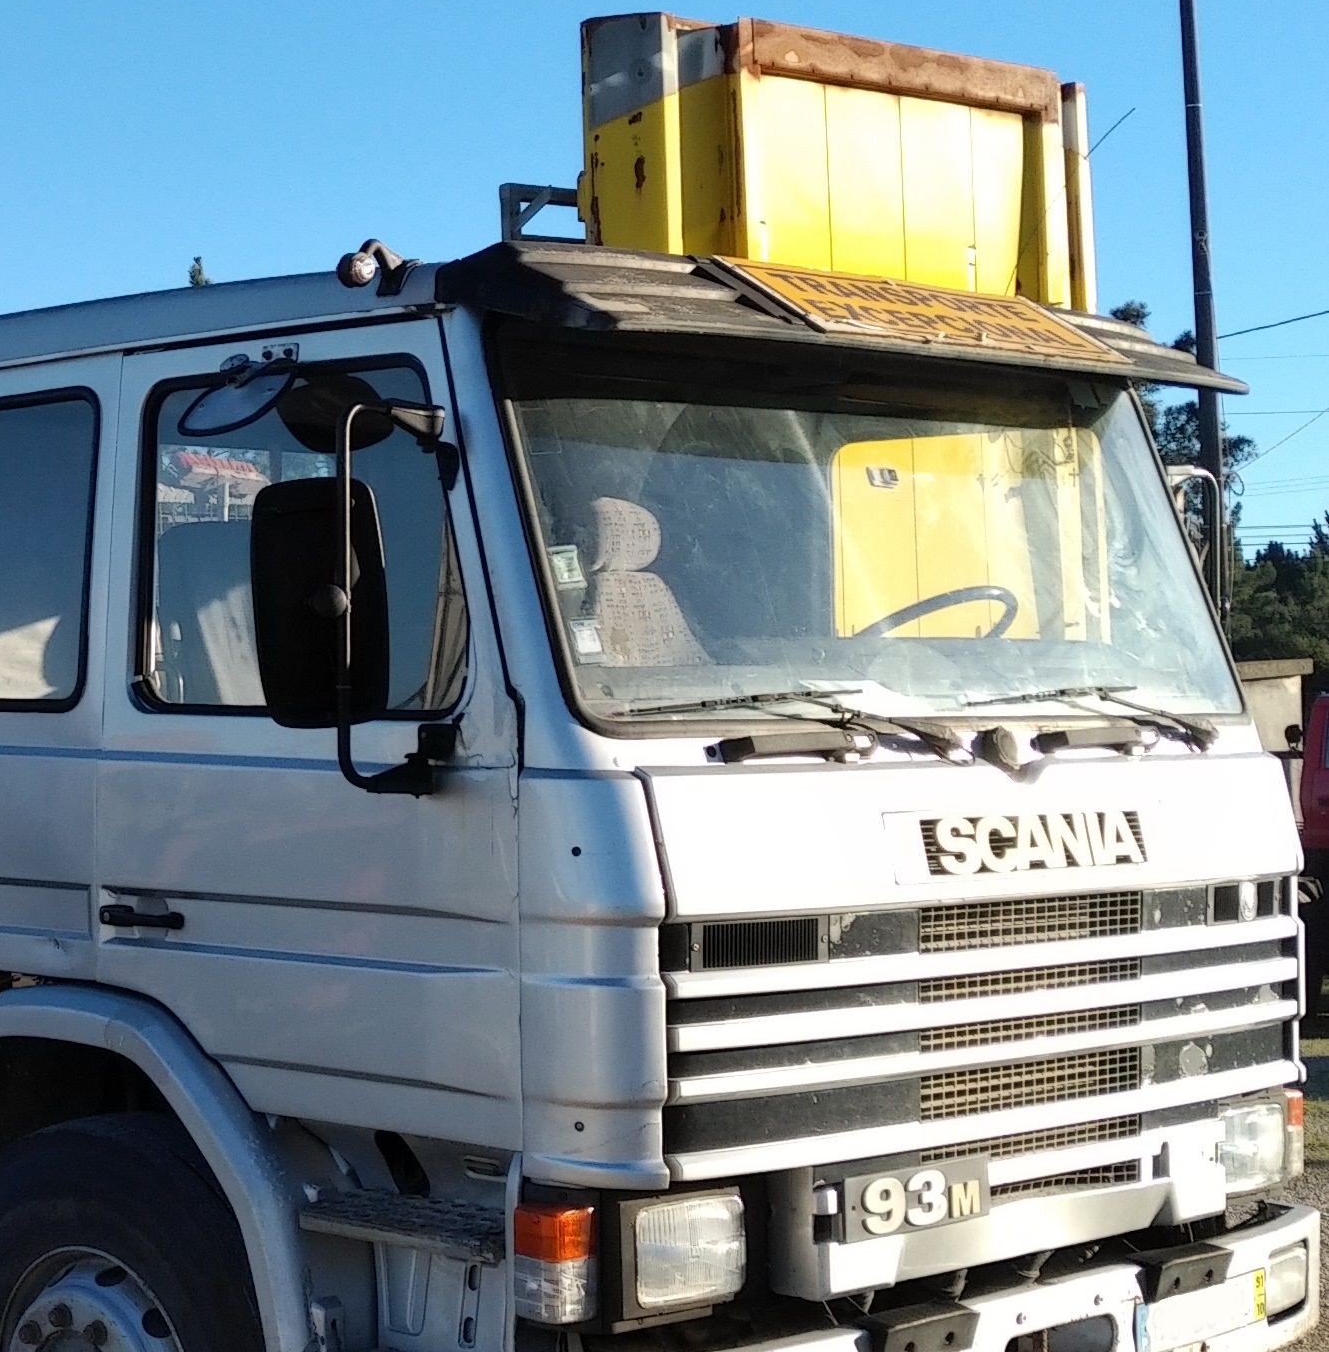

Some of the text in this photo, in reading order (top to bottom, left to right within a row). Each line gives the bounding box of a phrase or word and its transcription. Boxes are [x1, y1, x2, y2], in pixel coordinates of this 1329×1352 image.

[767, 272, 1039, 323] TRANSPORTE
[803, 297, 1088, 348] EXCEPCIONAL
[935, 811, 1145, 875] SCANIA
